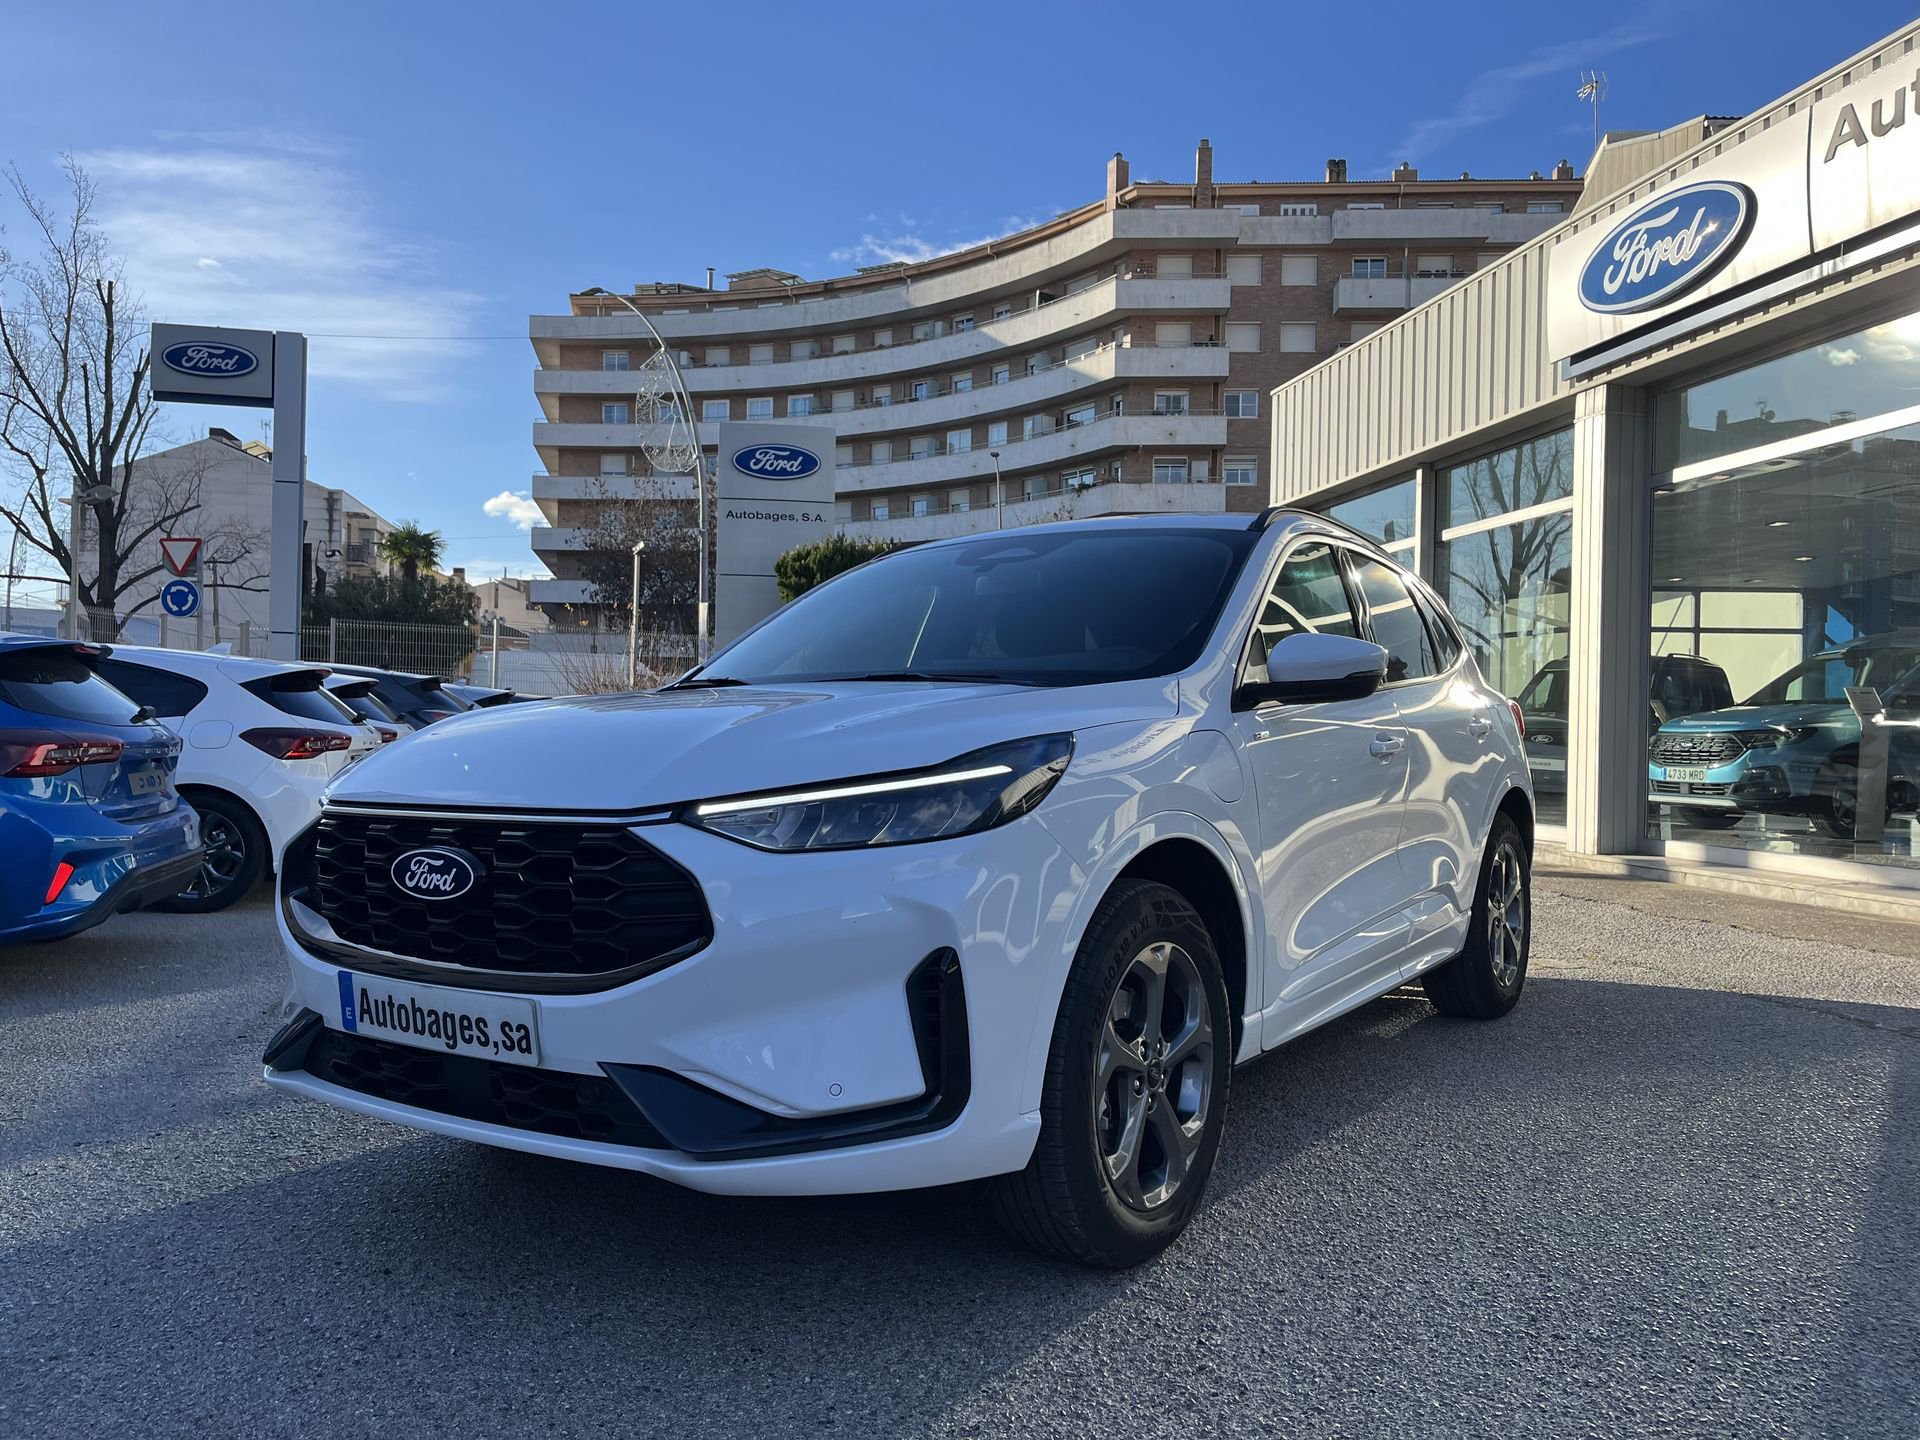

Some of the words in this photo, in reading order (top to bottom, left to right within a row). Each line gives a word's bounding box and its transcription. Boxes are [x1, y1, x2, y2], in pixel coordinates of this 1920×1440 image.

[1603, 206, 1706, 295] Ford
[181, 346, 240, 370] Ford
[749, 448, 804, 472] Ford
[725, 509, 799, 523] Autobages,
[801, 512, 827, 523] S.A.
[1667, 768, 1687, 780] 4733
[1688, 769, 1705, 781] MRD
[405, 856, 457, 892] Ford
[345, 1006, 353, 1020] E
[359, 987, 533, 1056] Autobages,sa
